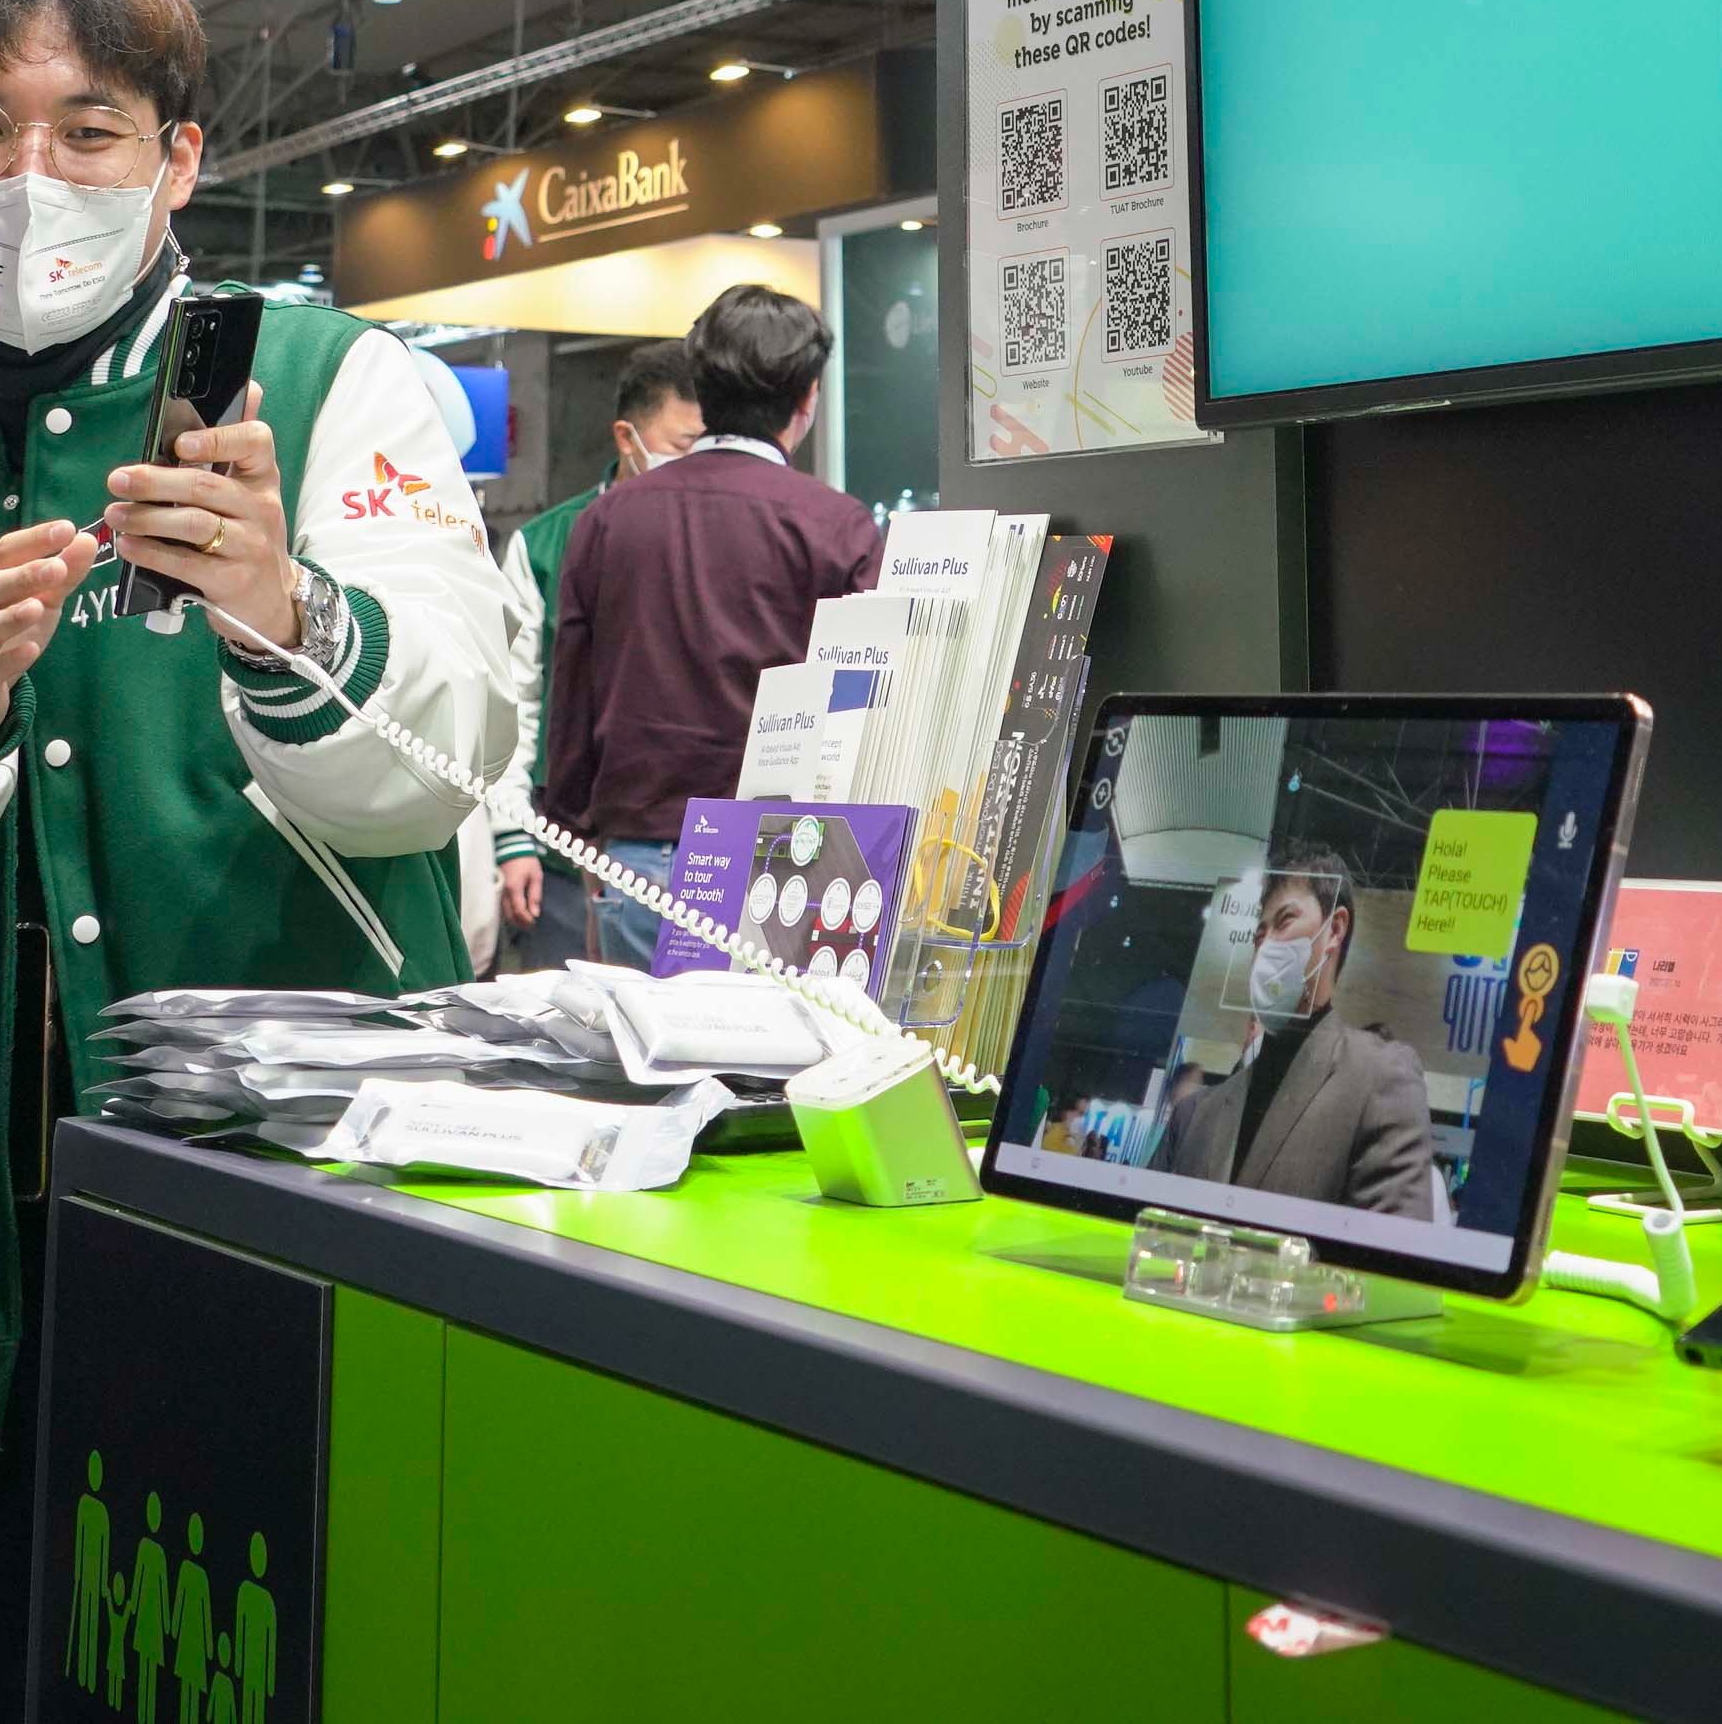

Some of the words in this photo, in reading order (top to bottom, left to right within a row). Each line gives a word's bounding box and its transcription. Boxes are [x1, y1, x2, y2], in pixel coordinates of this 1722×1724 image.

[1030, 8, 1052, 35] by
[1014, 39, 1062, 70] these
[1065, 31, 1090, 59] QR
[1095, 14, 1151, 50] codes!
[538, 138, 688, 227] CaixaBank
[1131, 195, 1164, 215] Brochure
[1017, 218, 1049, 233] Brochure
[48, 269, 65, 283] SK
[68, 261, 102, 277] telecom
[1122, 362, 1153, 378] Youtube
[1022, 376, 1049, 391] Website
[342, 488, 396, 520] SK
[891, 557, 938, 576] Sullivan
[942, 557, 969, 575] Plus
[817, 647, 861, 664] Sullivan
[864, 646, 888, 664] Plus
[757, 714, 792, 734] Sullivan
[795, 712, 815, 731] Plus
[1433, 841, 1468, 858] Hola!
[688, 852, 713, 866] Smart
[714, 854, 731, 868] way
[684, 871, 694, 882] to
[695, 871, 713, 884] tour
[1428, 865, 1472, 884] Please
[680, 889, 696, 900] our
[697, 888, 725, 903] booth!
[1424, 889, 1508, 916] TAP(TOUCH)
[1417, 916, 1455, 933] Here!!
